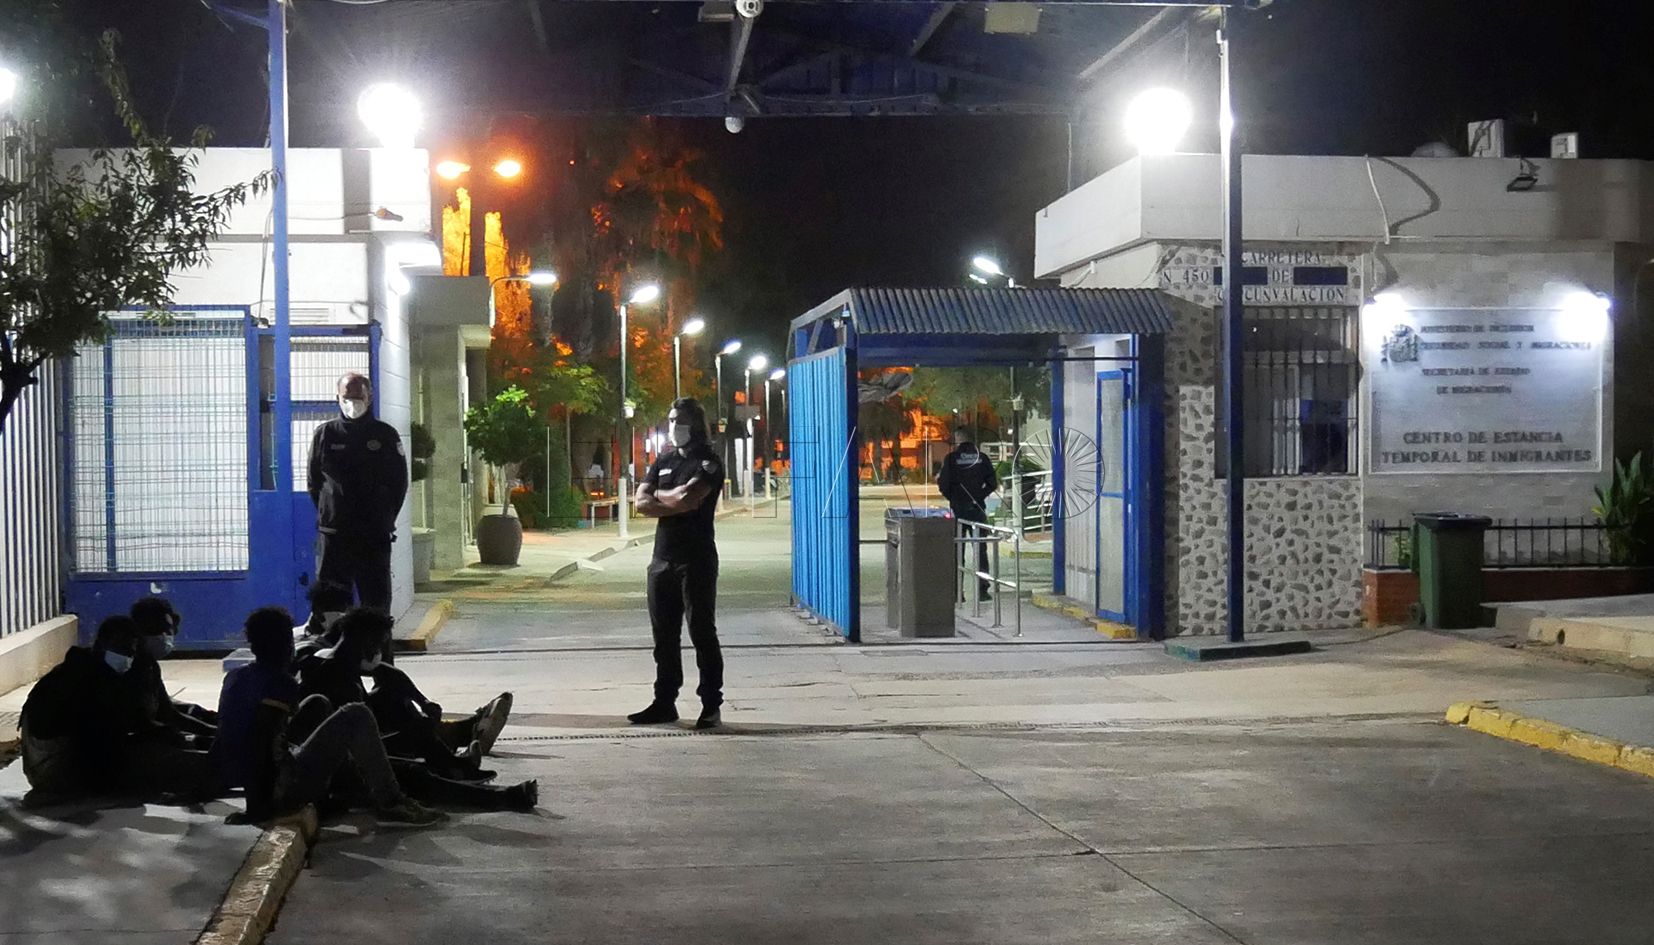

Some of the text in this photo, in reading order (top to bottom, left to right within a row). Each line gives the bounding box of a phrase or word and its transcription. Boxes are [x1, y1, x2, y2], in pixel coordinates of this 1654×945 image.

[1271, 269, 1289, 283] DE
[1217, 287, 1344, 302] CCUNVALACION
[1403, 432, 1563, 444] CENTRO DE ESTANCIA
[1382, 450, 1592, 463] TEMPORAL DE INMIGRANTES
